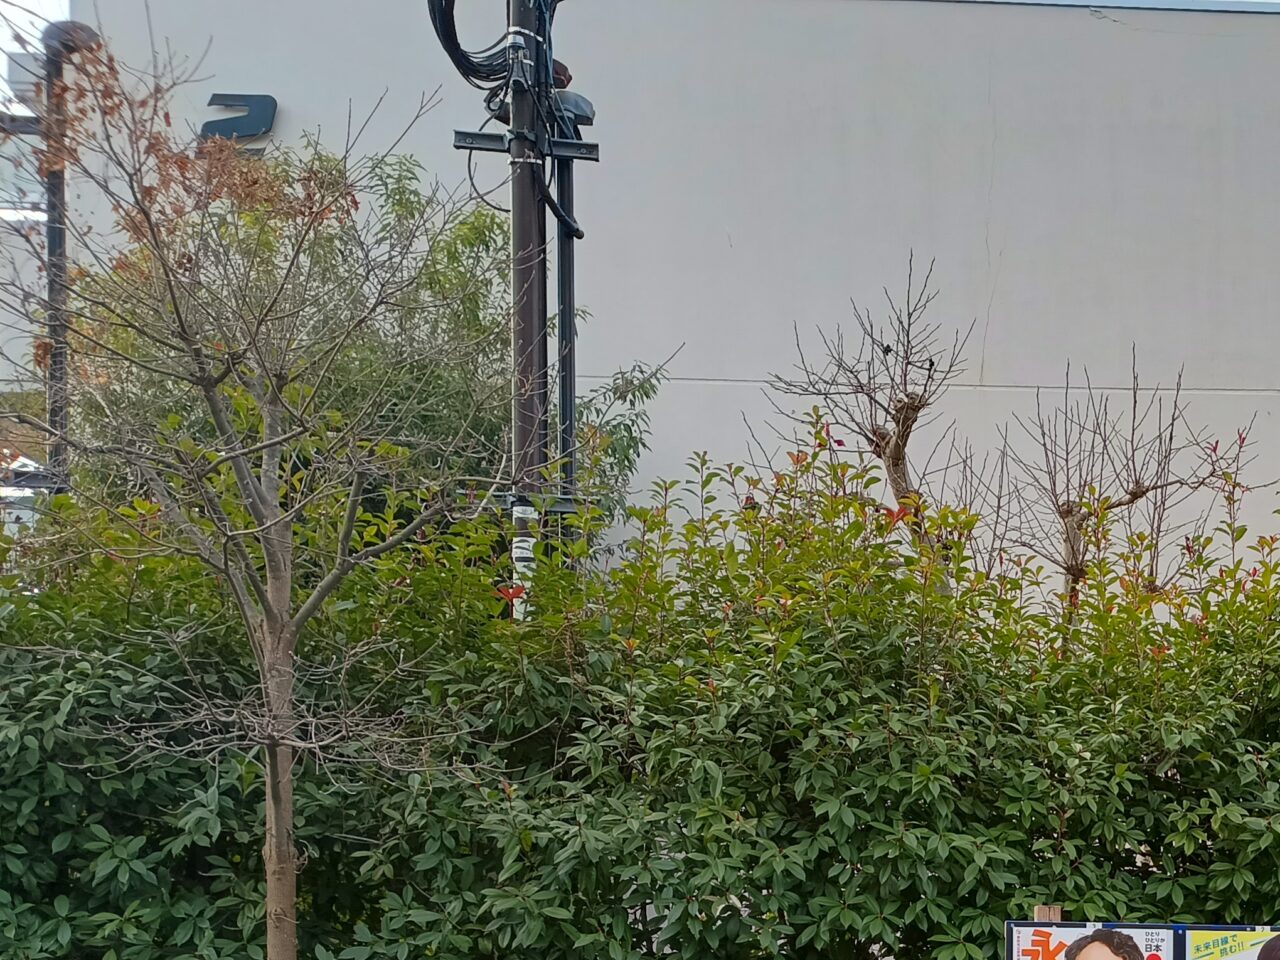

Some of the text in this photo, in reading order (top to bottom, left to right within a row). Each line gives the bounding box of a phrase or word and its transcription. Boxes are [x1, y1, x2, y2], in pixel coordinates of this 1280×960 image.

[1145, 943, 1162, 953] 日本
[1194, 934, 1238, 954] 未来目線で
